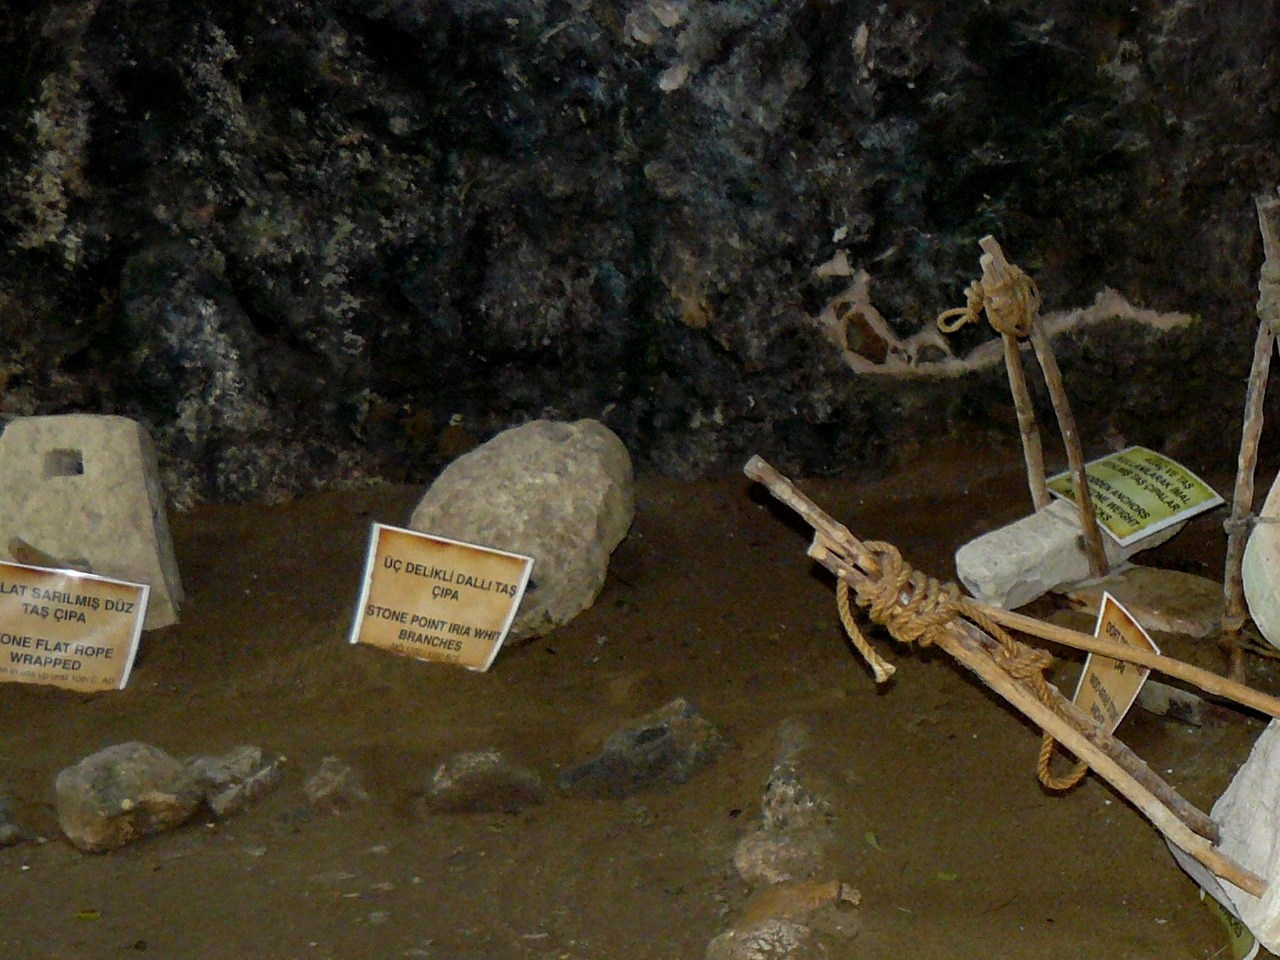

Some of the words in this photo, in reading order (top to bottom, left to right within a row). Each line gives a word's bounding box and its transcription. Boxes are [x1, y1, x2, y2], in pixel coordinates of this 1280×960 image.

[1110, 487, 1151, 520] ANCHORS
[384, 556, 403, 574] ÜÇ
[406, 561, 454, 582] DELİKLİ
[456, 573, 492, 592] DALLI
[494, 581, 519, 598] TAŞ
[0, 582, 28, 597] LAT
[32, 587, 100, 610] SARILMIŞ
[105, 598, 135, 614] DÜZ
[431, 585, 459, 601] ÇIPA
[23, 602, 49, 620] TAŞ
[54, 608, 87, 624] ÇIPA
[366, 604, 409, 624] STONE
[410, 614, 448, 632] POINT
[449, 620, 472, 635] IRIA
[0, 633, 32, 649] ONE
[35, 638, 71, 654] FLAT
[398, 628, 463, 652] BRANCHES
[10, 652, 82, 671] WRAPPED
